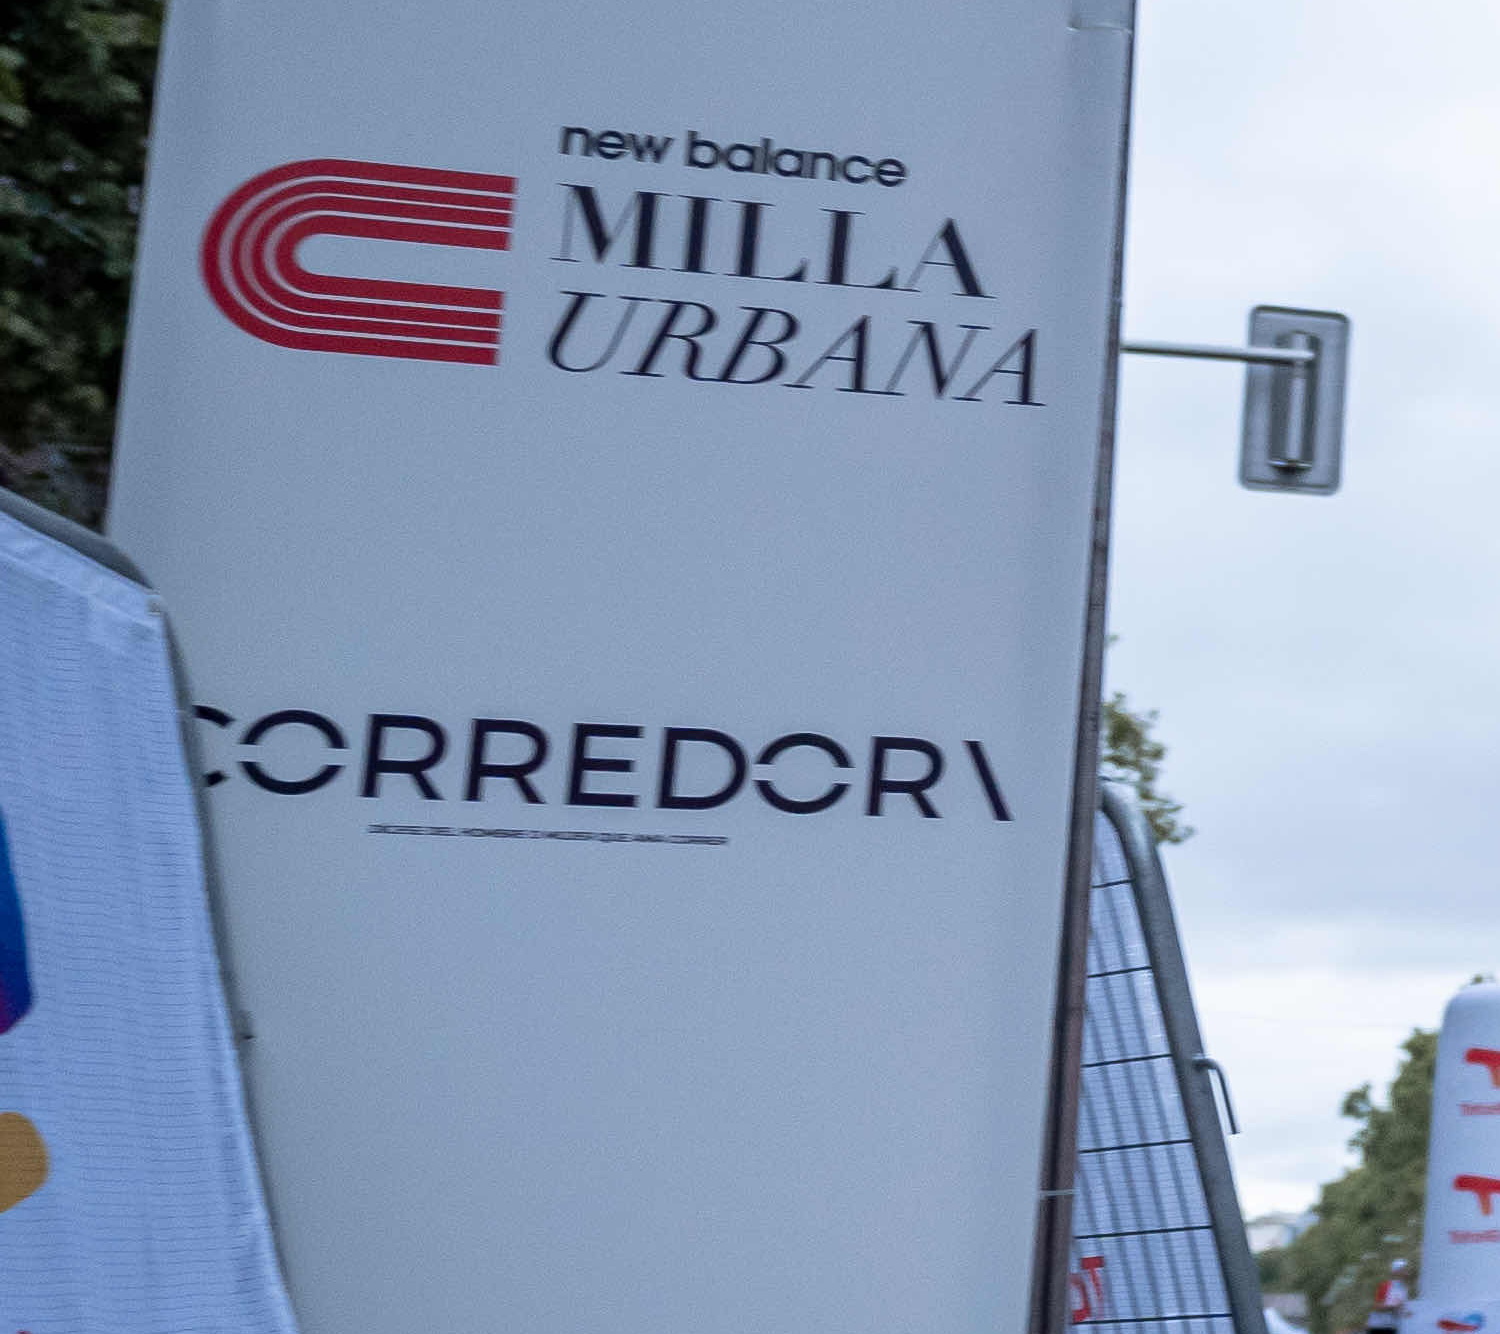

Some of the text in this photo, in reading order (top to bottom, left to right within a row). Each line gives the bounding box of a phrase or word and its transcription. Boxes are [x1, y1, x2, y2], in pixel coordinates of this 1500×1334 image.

[559, 122, 908, 188] new balance
[552, 183, 997, 300] MILLA
[545, 290, 1047, 407] URBANA
